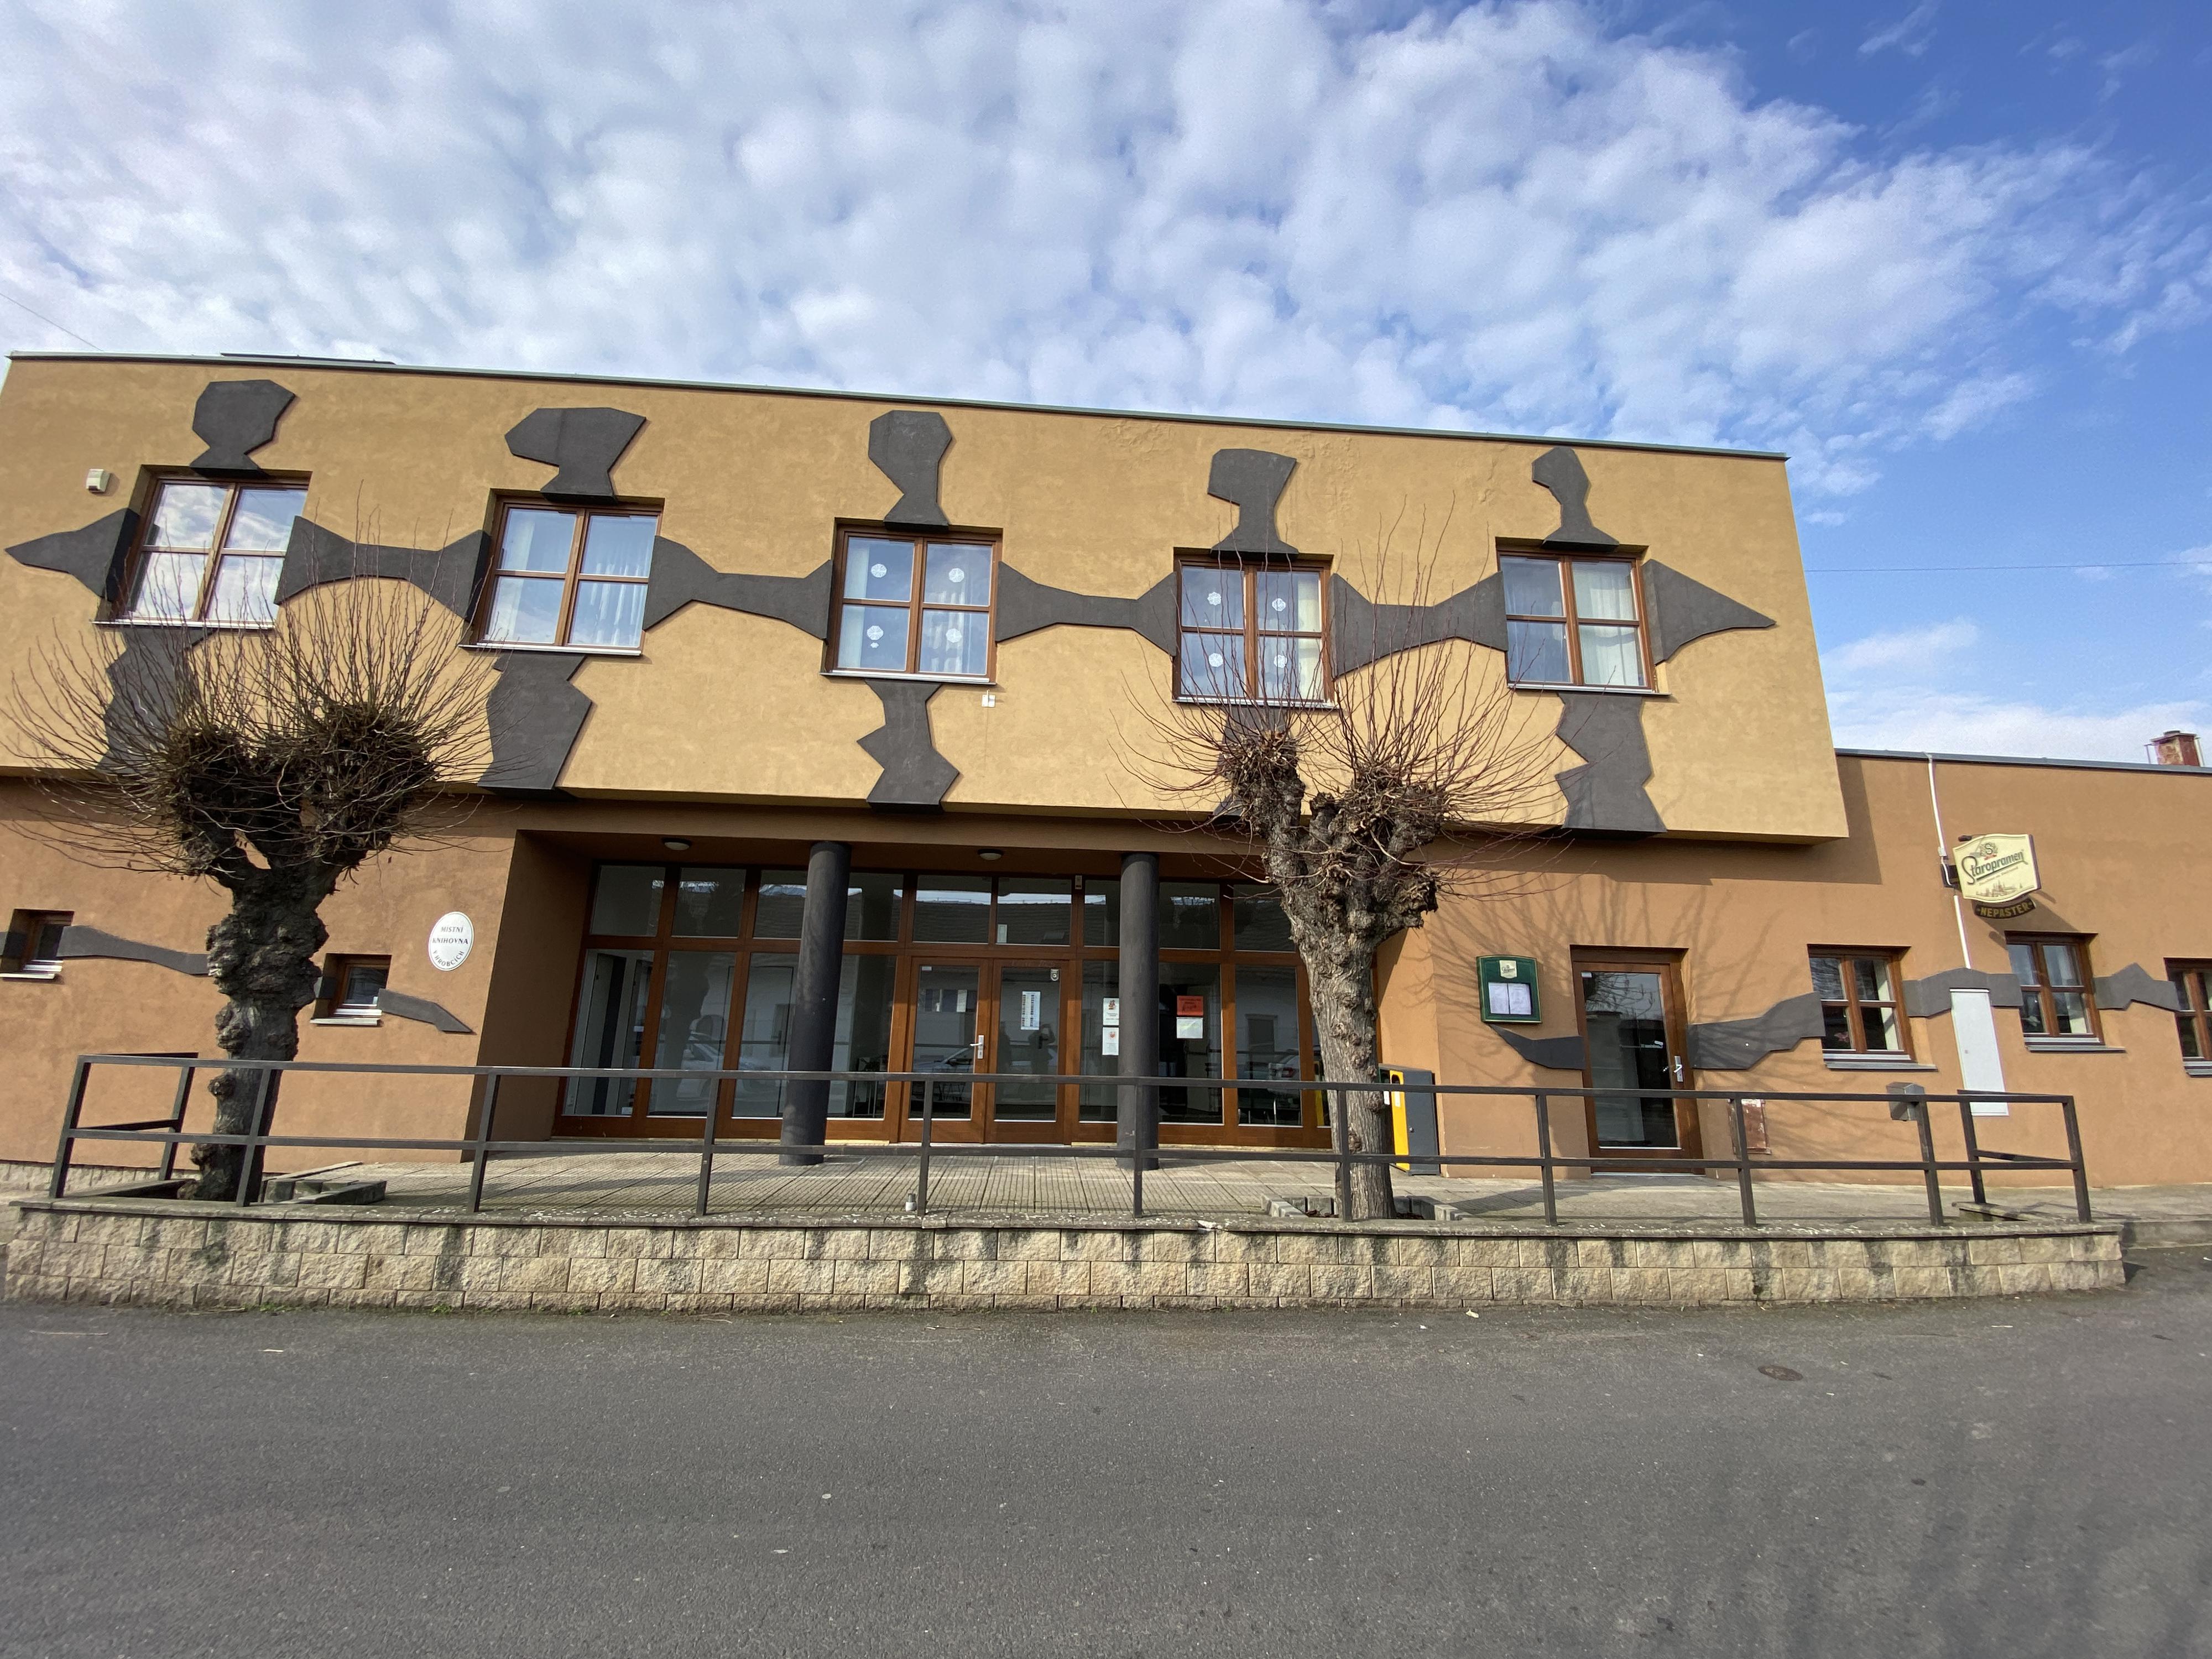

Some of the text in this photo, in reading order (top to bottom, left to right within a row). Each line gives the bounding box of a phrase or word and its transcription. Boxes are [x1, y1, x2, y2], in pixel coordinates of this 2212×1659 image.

[1984, 843, 1993, 855] S
[1961, 851, 2024, 885] Staropramen
[1980, 902, 2030, 918] NEPASTER
